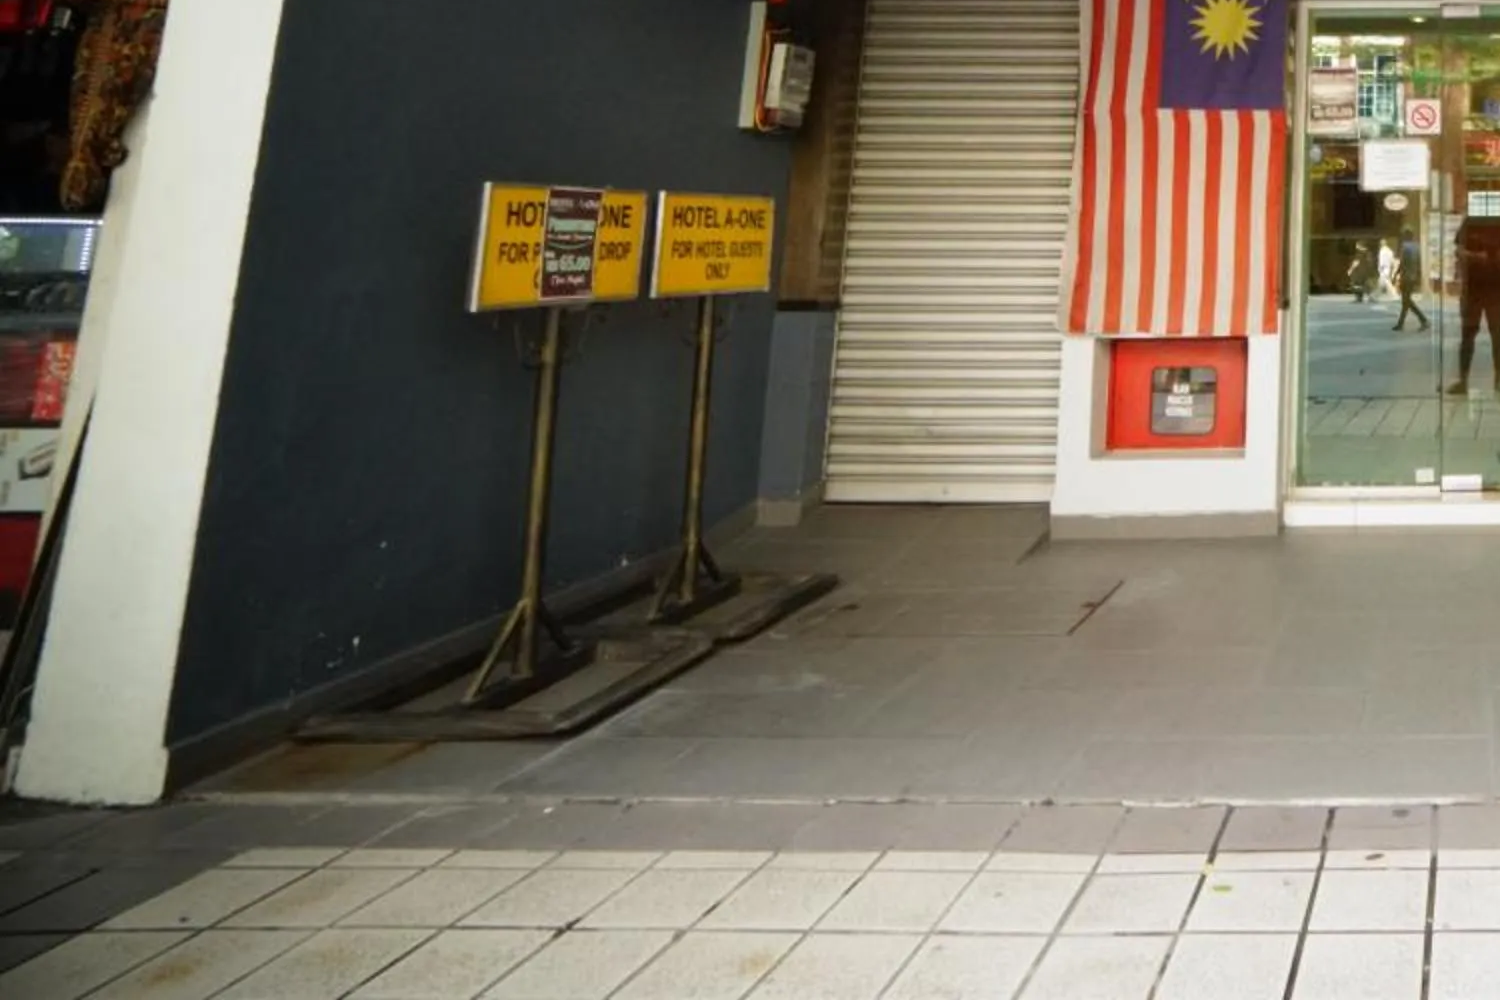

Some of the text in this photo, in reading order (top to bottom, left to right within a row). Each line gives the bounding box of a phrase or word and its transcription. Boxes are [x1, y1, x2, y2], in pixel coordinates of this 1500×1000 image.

[672, 205, 766, 230] HOTEL A-ONE
[498, 241, 529, 265] FOR
[671, 240, 693, 259] FOR
[705, 261, 731, 281] ONLY
